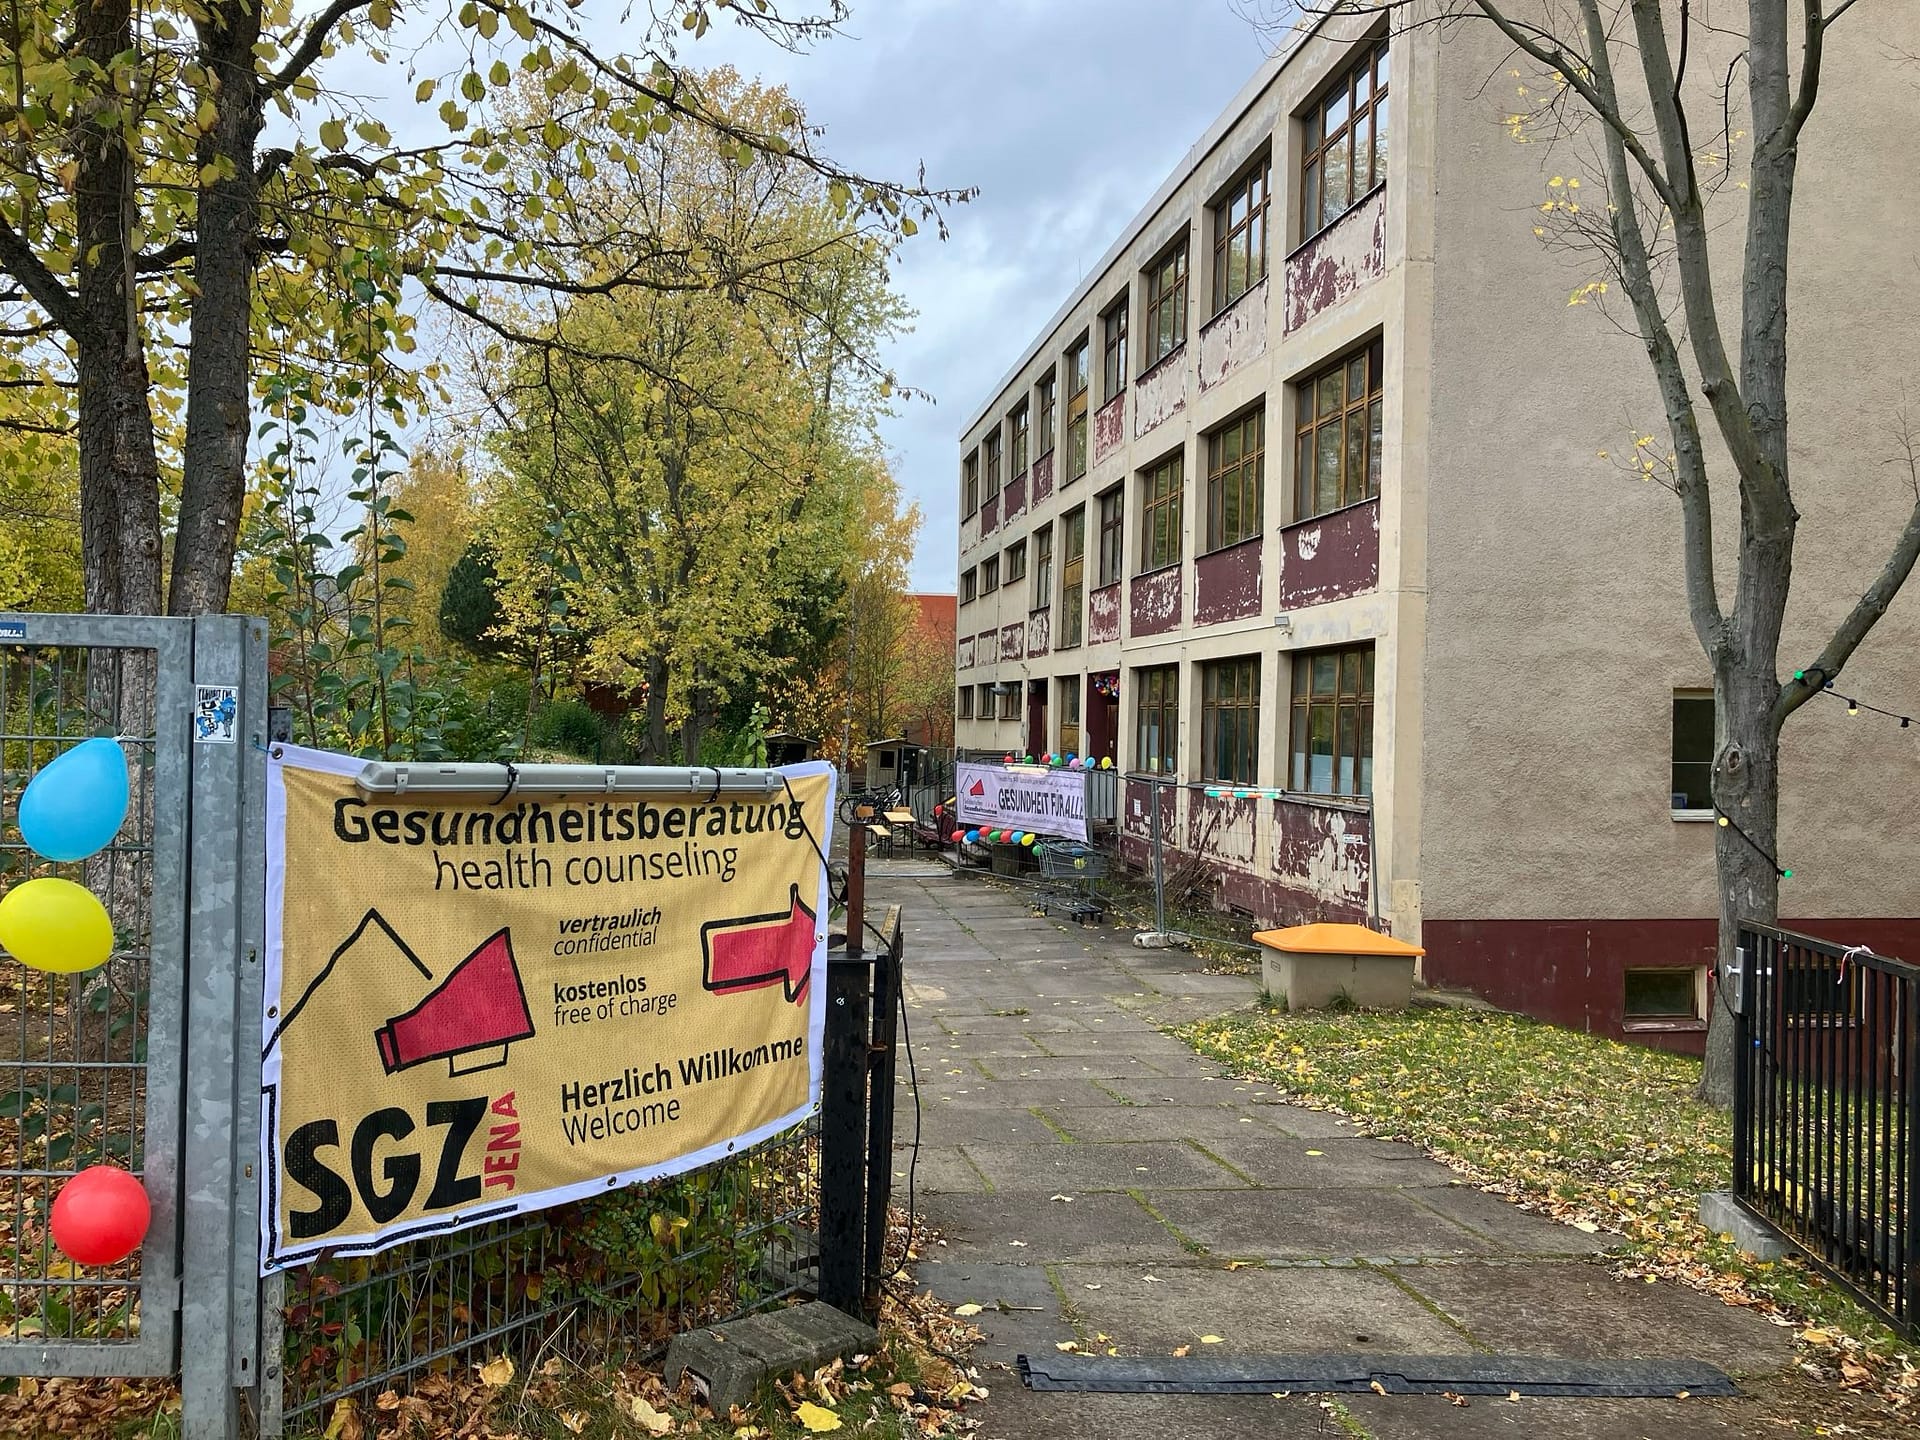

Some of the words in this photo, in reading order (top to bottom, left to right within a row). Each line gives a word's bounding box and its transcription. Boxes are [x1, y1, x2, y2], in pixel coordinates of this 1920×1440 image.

[333, 797, 805, 846] Gesundheitsberatung
[998, 788, 1049, 815] GESUNDHEIT
[1050, 789, 1065, 817] FÜR
[432, 848, 552, 891] health
[564, 841, 739, 887] counseling
[553, 925, 658, 956] confidential
[559, 906, 662, 934] vertraulich
[554, 974, 647, 1004] kostenlos
[554, 1004, 591, 1027] free
[596, 997, 615, 1020] of
[620, 993, 677, 1016] charge
[561, 1062, 673, 1114] Herzlich
[678, 1036, 803, 1086] Willkomme
[561, 1098, 681, 1146] Welcome
[284, 1095, 490, 1239] SGZ
[484, 1090, 522, 1192] JENA
